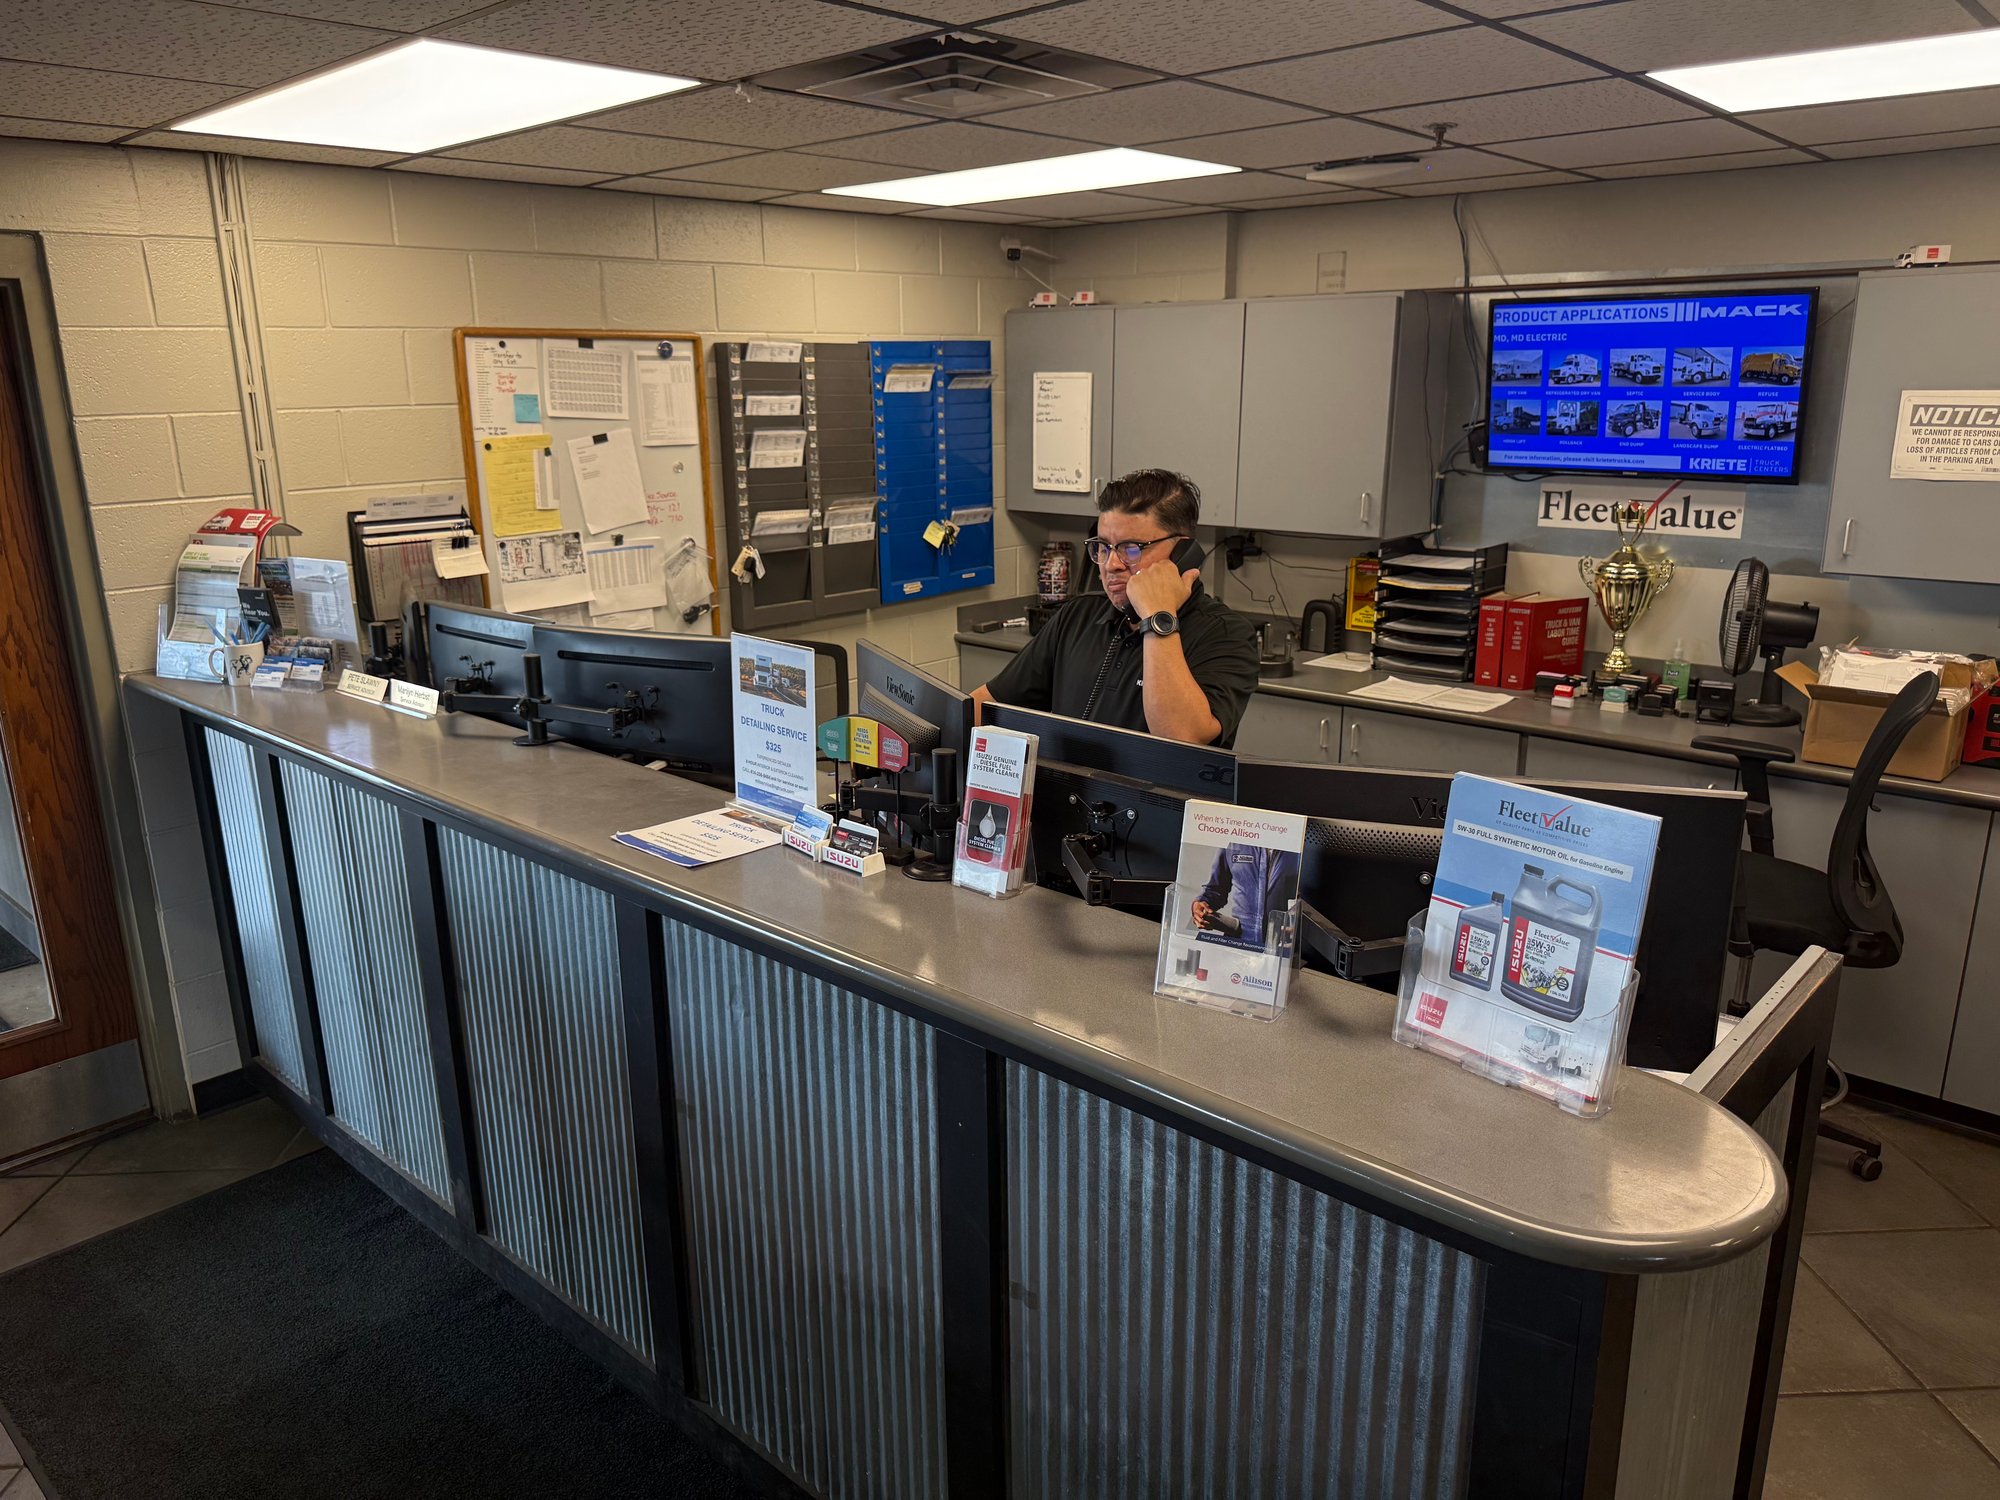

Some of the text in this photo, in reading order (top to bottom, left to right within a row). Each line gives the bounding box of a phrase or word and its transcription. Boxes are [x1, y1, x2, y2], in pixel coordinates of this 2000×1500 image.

[1494, 307, 1669, 323] PRODUCT APPLICATIONS
[1700, 304, 1802, 318] MACK
[1493, 333, 1568, 343] MD, MD ELECTRIC
[1912, 406, 2000, 425] NOTIC
[1953, 429, 1961, 437] BE
[1931, 438, 1960, 446] DAMAGE
[1906, 446, 1923, 454] LOSS
[1925, 446, 1934, 454] OF
[1936, 447, 1968, 455] ARTICLES
[1689, 457, 1747, 471] KRIETE
[1929, 455, 1942, 463] THE
[1943, 456, 1973, 464] PARKING
[1975, 457, 1994, 465] AREA
[1545, 618, 1562, 630] TRUCK
[1569, 617, 1581, 626] VAN
[1547, 627, 1580, 639] LABOR TIME
[1561, 636, 1579, 646] GUIDE
[347, 672, 361, 684] PETE
[760, 703, 785, 717] TRUCK
[740, 715, 776, 733] DETAILING
[777, 725, 808, 742] SERVICE
[765, 740, 782, 753] $325
[976, 752, 1017, 766] ISUZU GENUINE
[980, 759, 1012, 771] DIESEL FUEL
[973, 763, 1020, 779] SYSTEM CLEANER
[1497, 799, 1539, 826] Fleet
[1193, 813, 1214, 822] When
[1215, 815, 1224, 824] It's
[1226, 817, 1242, 827] Time
[1243, 819, 1253, 828] For
[1261, 822, 1288, 835] Change
[1198, 823, 1260, 839] Choose Allison
[787, 834, 812, 853] ISUZU
[1456, 824, 1624, 876] 5W-30 FULL SYNTHETIC MOTOR OIL for Gasoline Engine
[826, 850, 859, 869] ISUZU
[1534, 929, 1550, 941] Fleet
[1457, 931, 1468, 963] ISUZU
[1511, 929, 1524, 973] ISUZU
[1526, 944, 1543, 956] MOTOR
[1531, 938, 1556, 954] 5W-30
[1243, 975, 1273, 987] Allison
[1420, 1004, 1443, 1017] ISUZU
